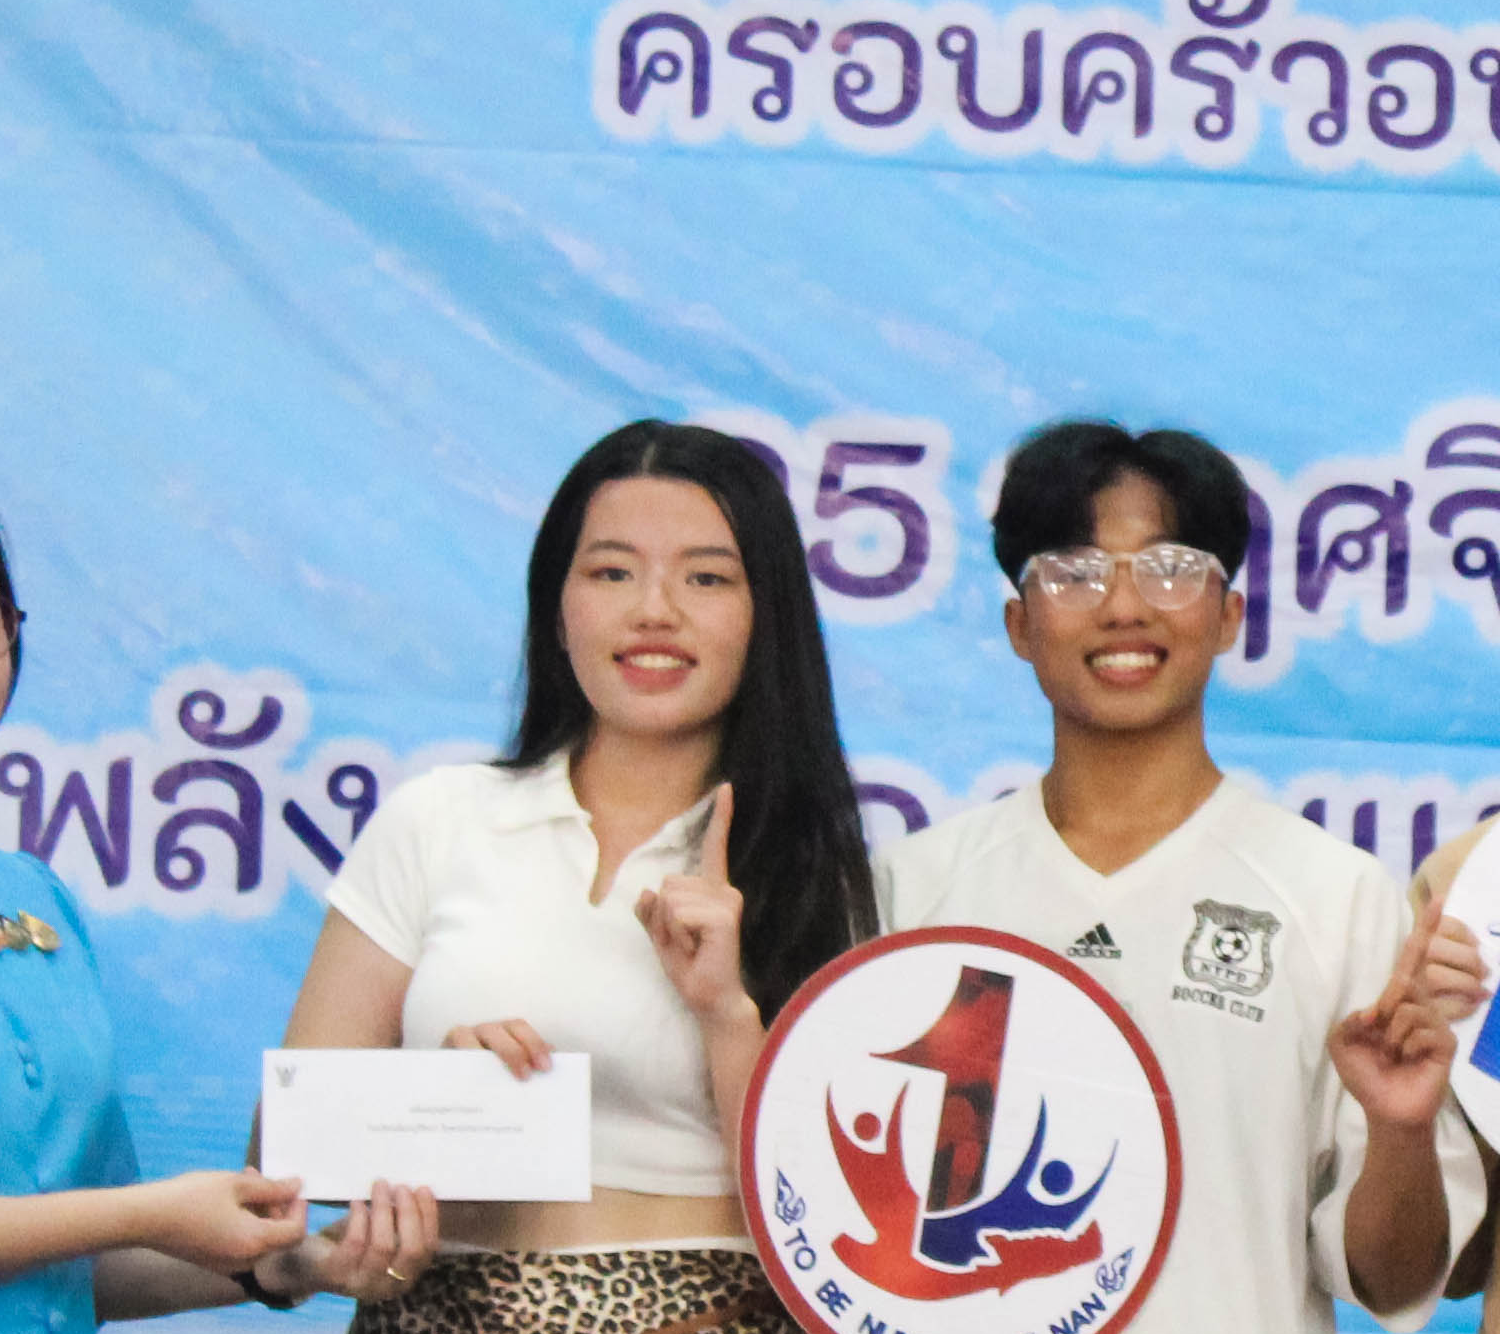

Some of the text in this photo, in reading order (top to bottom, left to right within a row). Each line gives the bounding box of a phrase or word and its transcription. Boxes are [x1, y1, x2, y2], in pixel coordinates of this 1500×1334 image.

[738, 436, 930, 599] 5
[869, 965, 1014, 1212] 1
[784, 1228, 816, 1271] TO
[816, 1280, 853, 1318] BE
